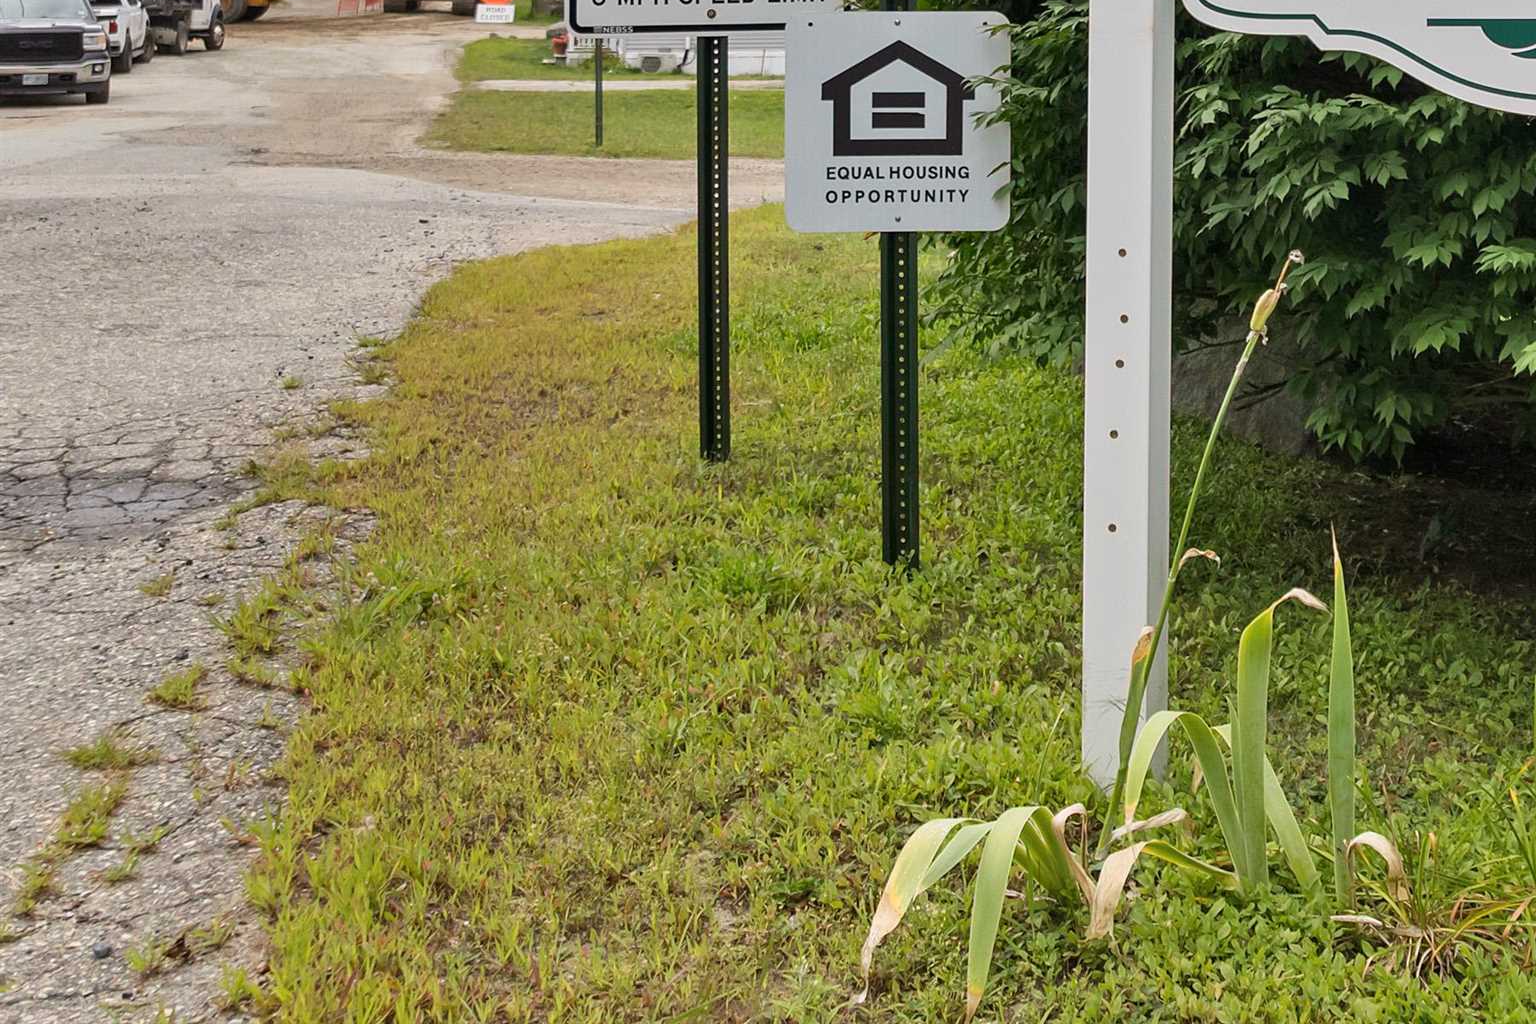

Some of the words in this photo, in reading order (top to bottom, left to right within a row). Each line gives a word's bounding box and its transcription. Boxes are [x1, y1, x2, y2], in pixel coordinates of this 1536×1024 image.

[826, 167, 885, 180] EQUAL
[889, 166, 969, 180] HOUSING
[826, 189, 969, 203] OPPORTUNITY
